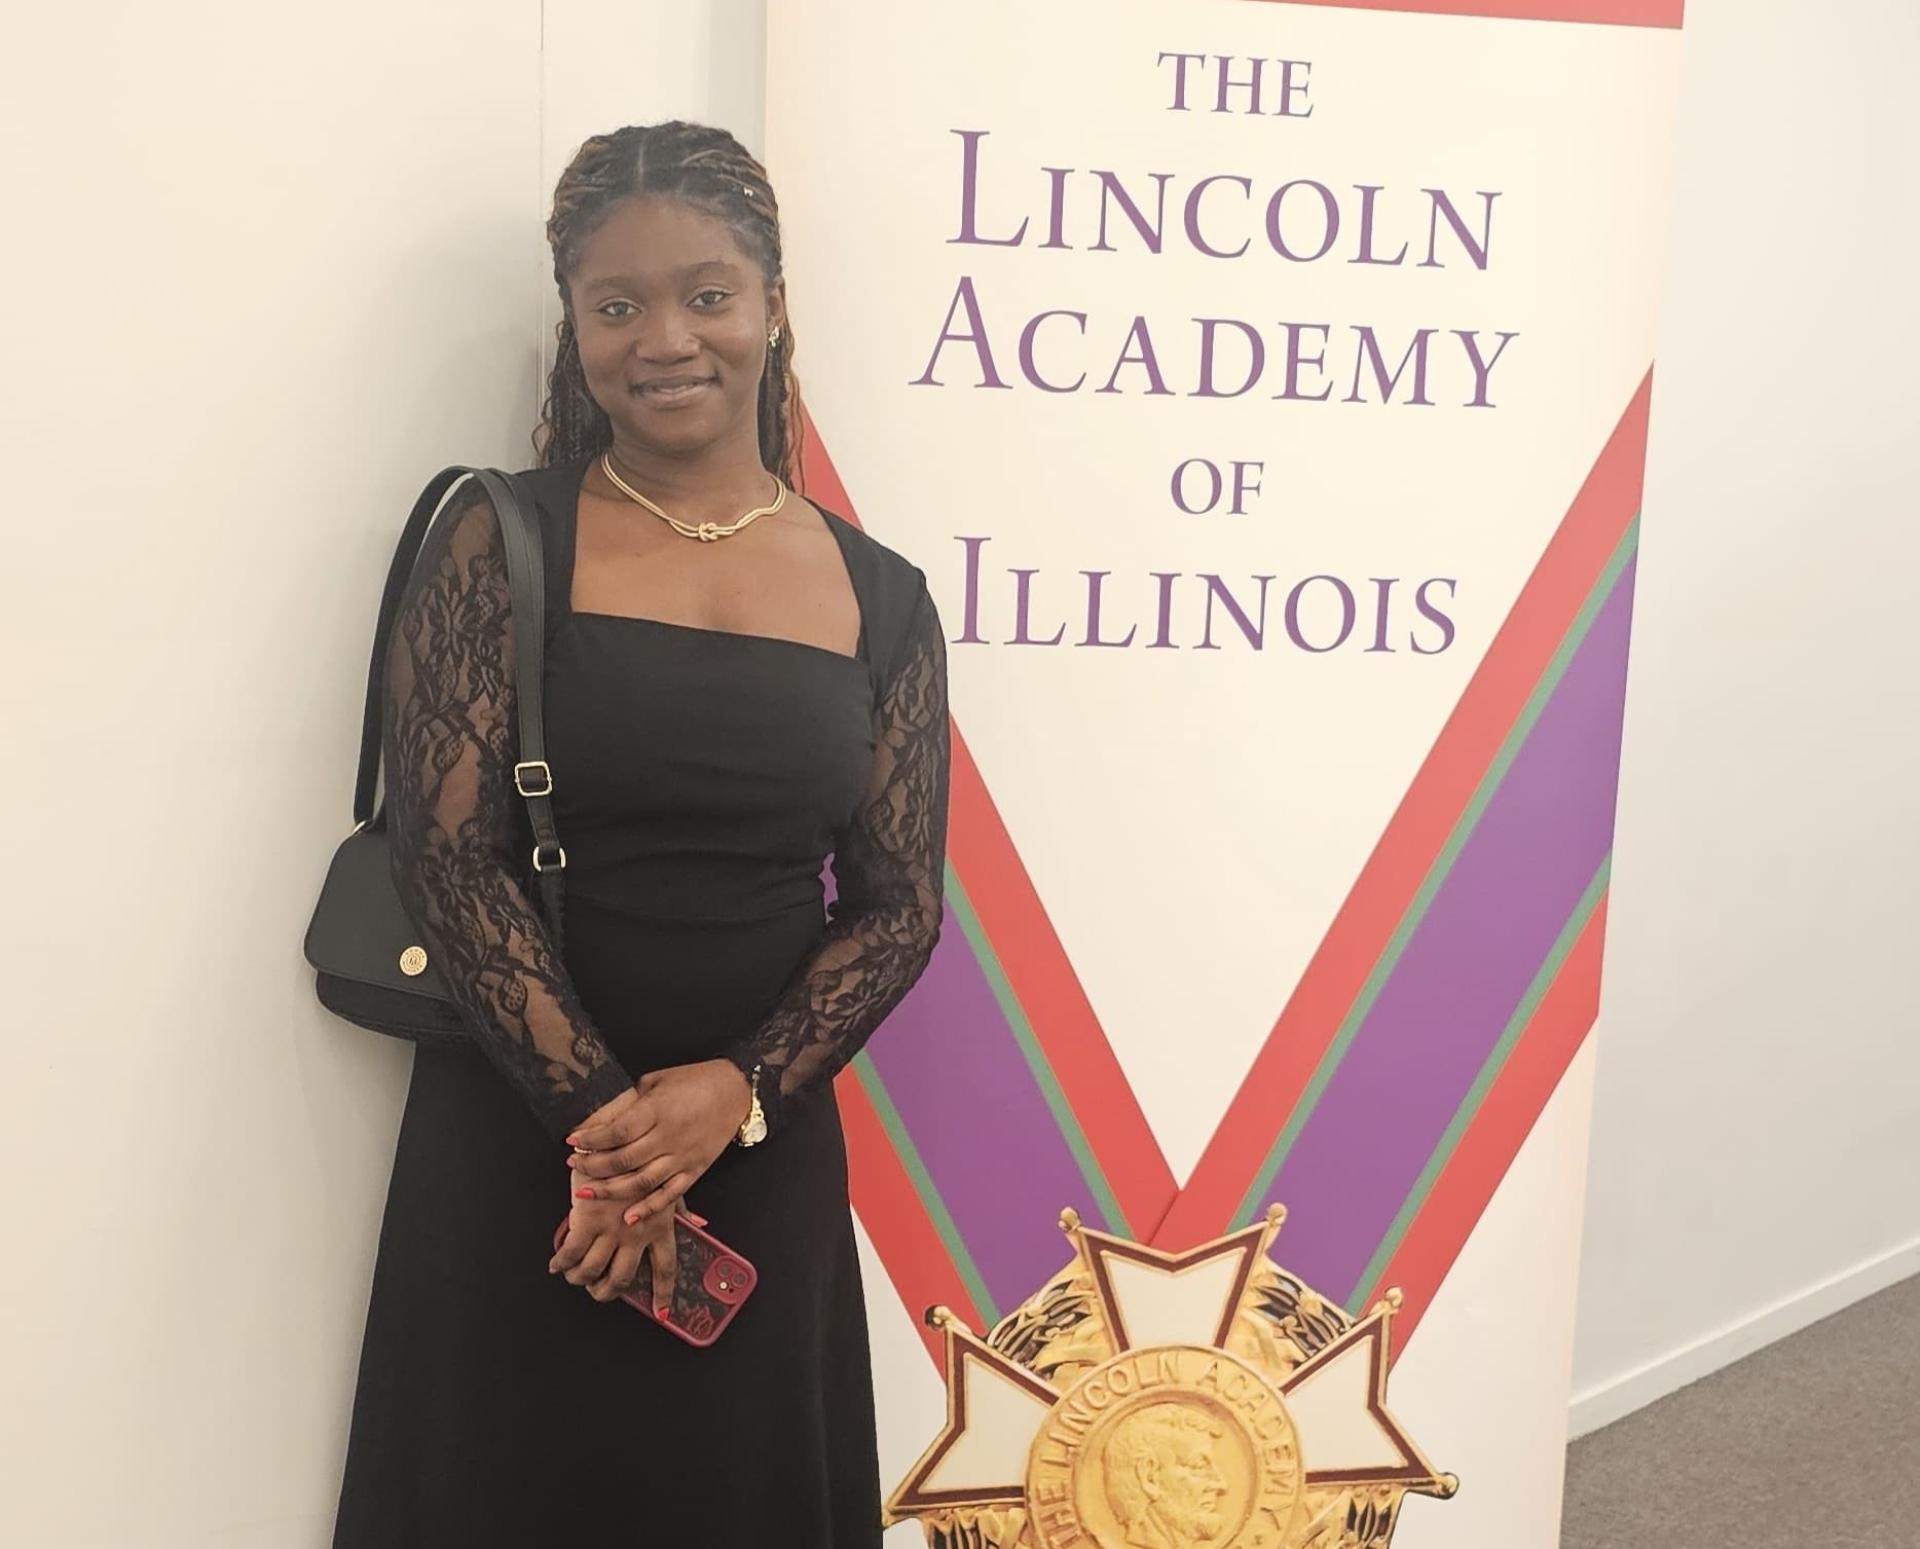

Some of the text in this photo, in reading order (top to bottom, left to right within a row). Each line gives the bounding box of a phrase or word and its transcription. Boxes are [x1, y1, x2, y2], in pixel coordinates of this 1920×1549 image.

[1157, 51, 1314, 118] THE
[1170, 457, 1265, 516] OF
[1040, 1353, 1182, 1468] LINCOLN
[1195, 1360, 1295, 1531] ACADEMY
